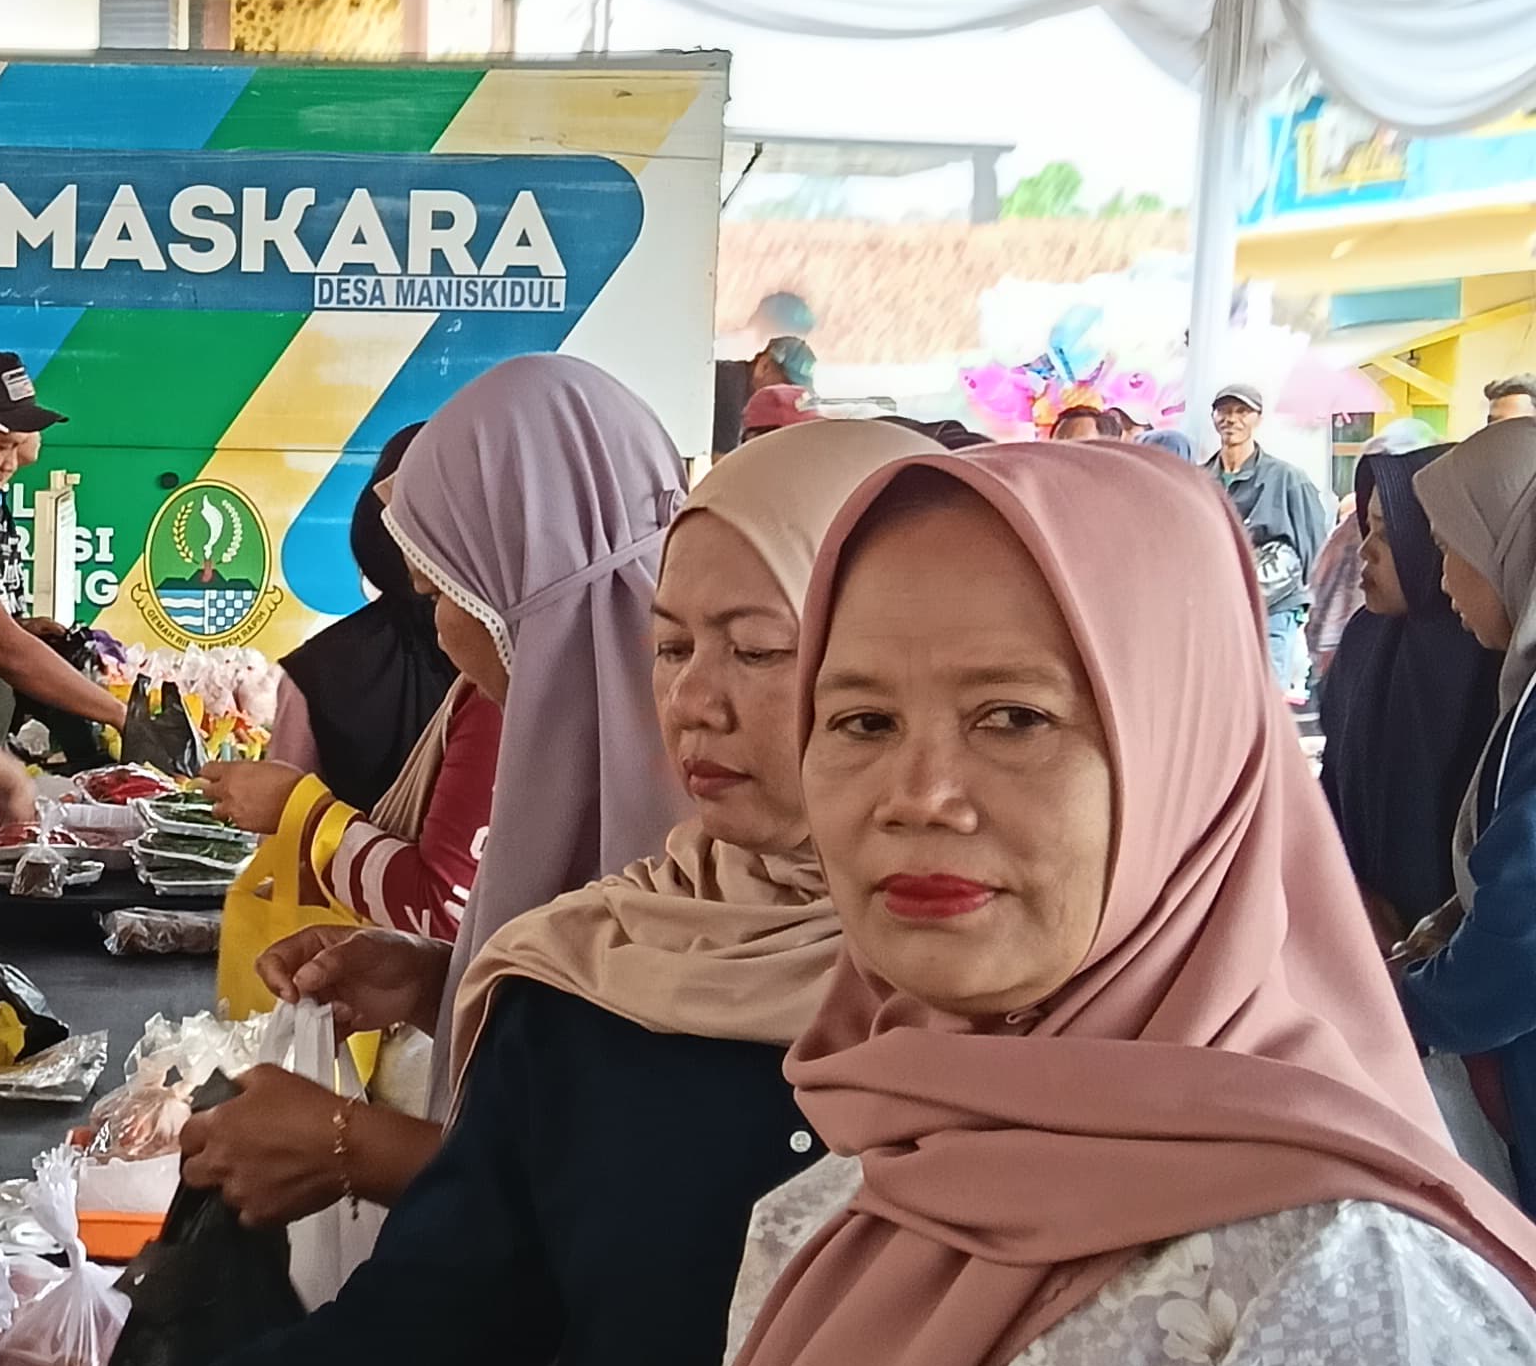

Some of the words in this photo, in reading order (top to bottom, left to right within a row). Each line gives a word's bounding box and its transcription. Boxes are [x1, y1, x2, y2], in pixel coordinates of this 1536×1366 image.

[318, 277, 386, 306] DESA
[395, 278, 561, 308] MANISKIDUL
[147, 608, 175, 643] GEMAH
[241, 610, 266, 636] RAPIH
